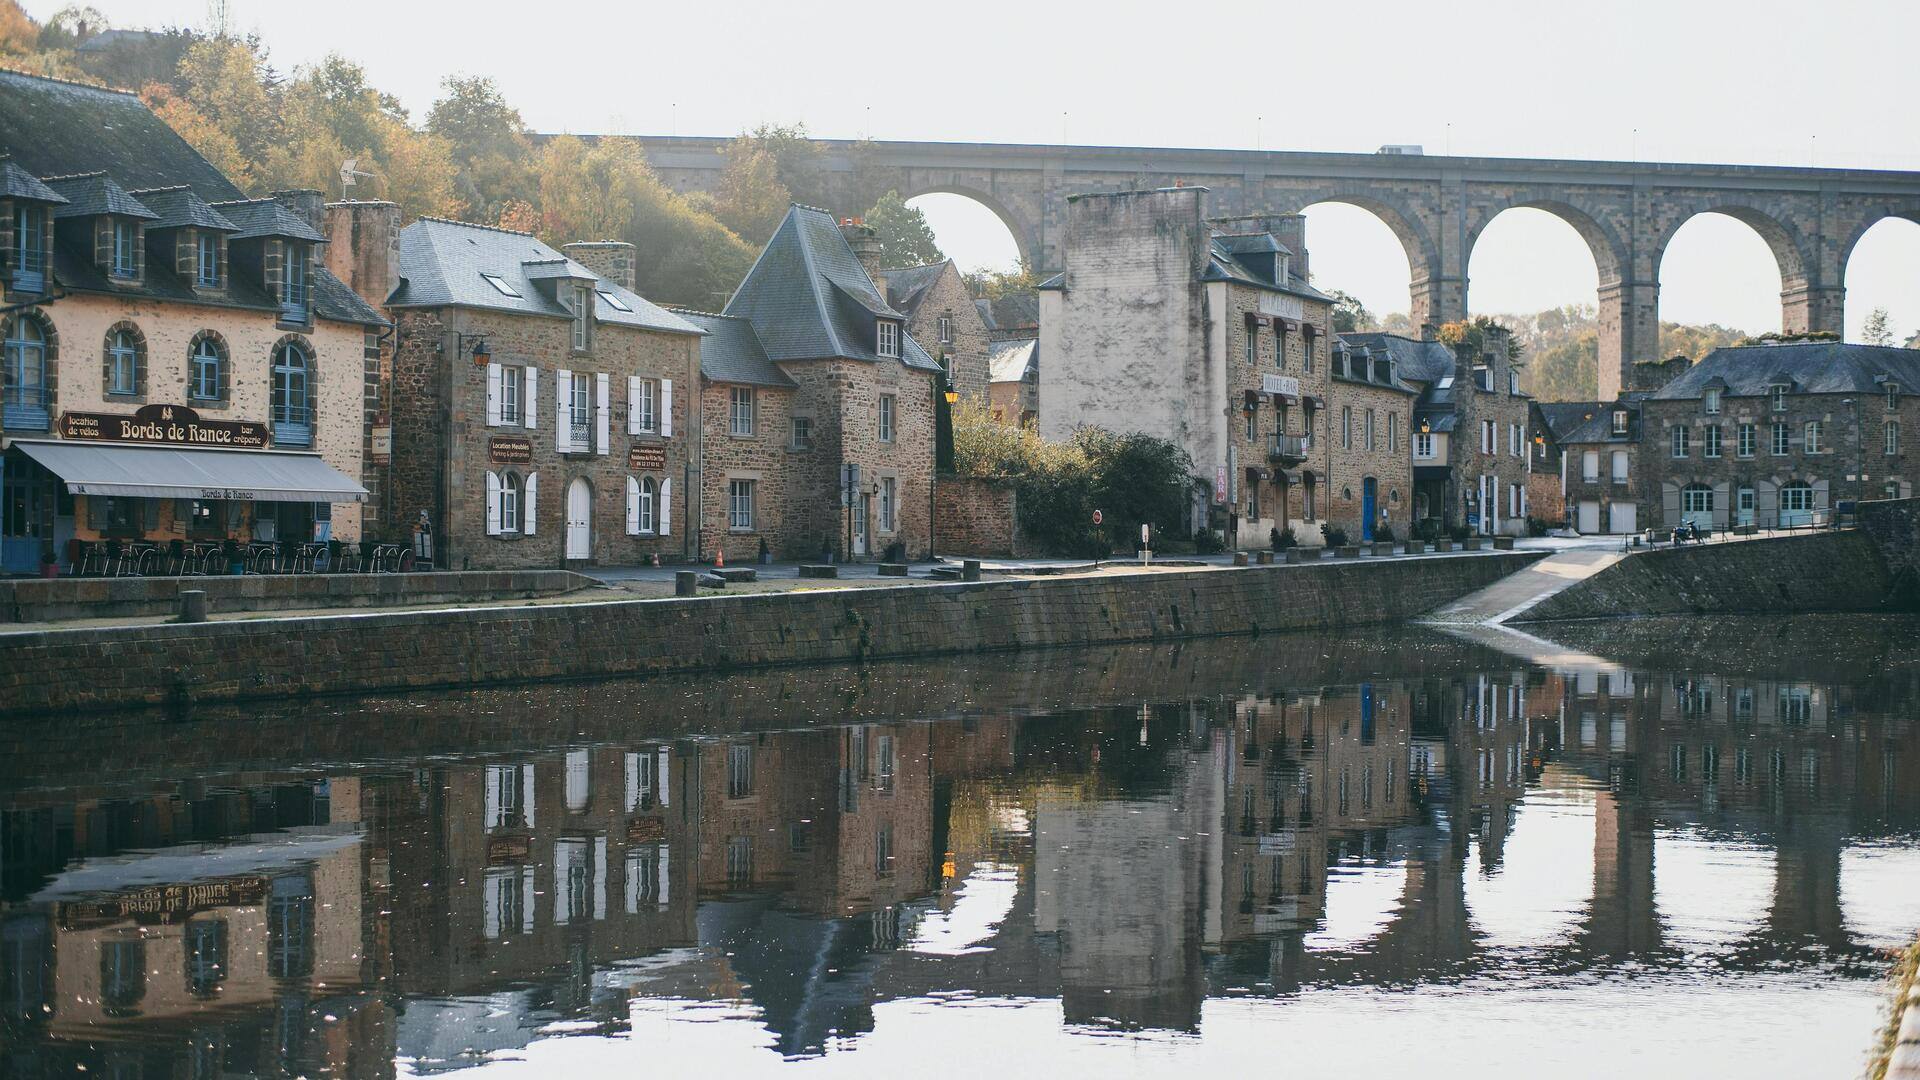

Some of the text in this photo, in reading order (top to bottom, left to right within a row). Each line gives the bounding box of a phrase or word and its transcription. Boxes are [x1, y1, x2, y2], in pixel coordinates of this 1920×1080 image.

[1285, 380, 1298, 393] BAR
[69, 416, 99, 426] location
[68, 427, 99, 436] de vélos
[120, 420, 231, 443] Bords de Rance
[241, 426, 254, 434] bar
[233, 435, 261, 445] crêperie
[1217, 467, 1225, 493] BAR
[201, 489, 222, 498] Bords
[232, 490, 254, 499] Rance
